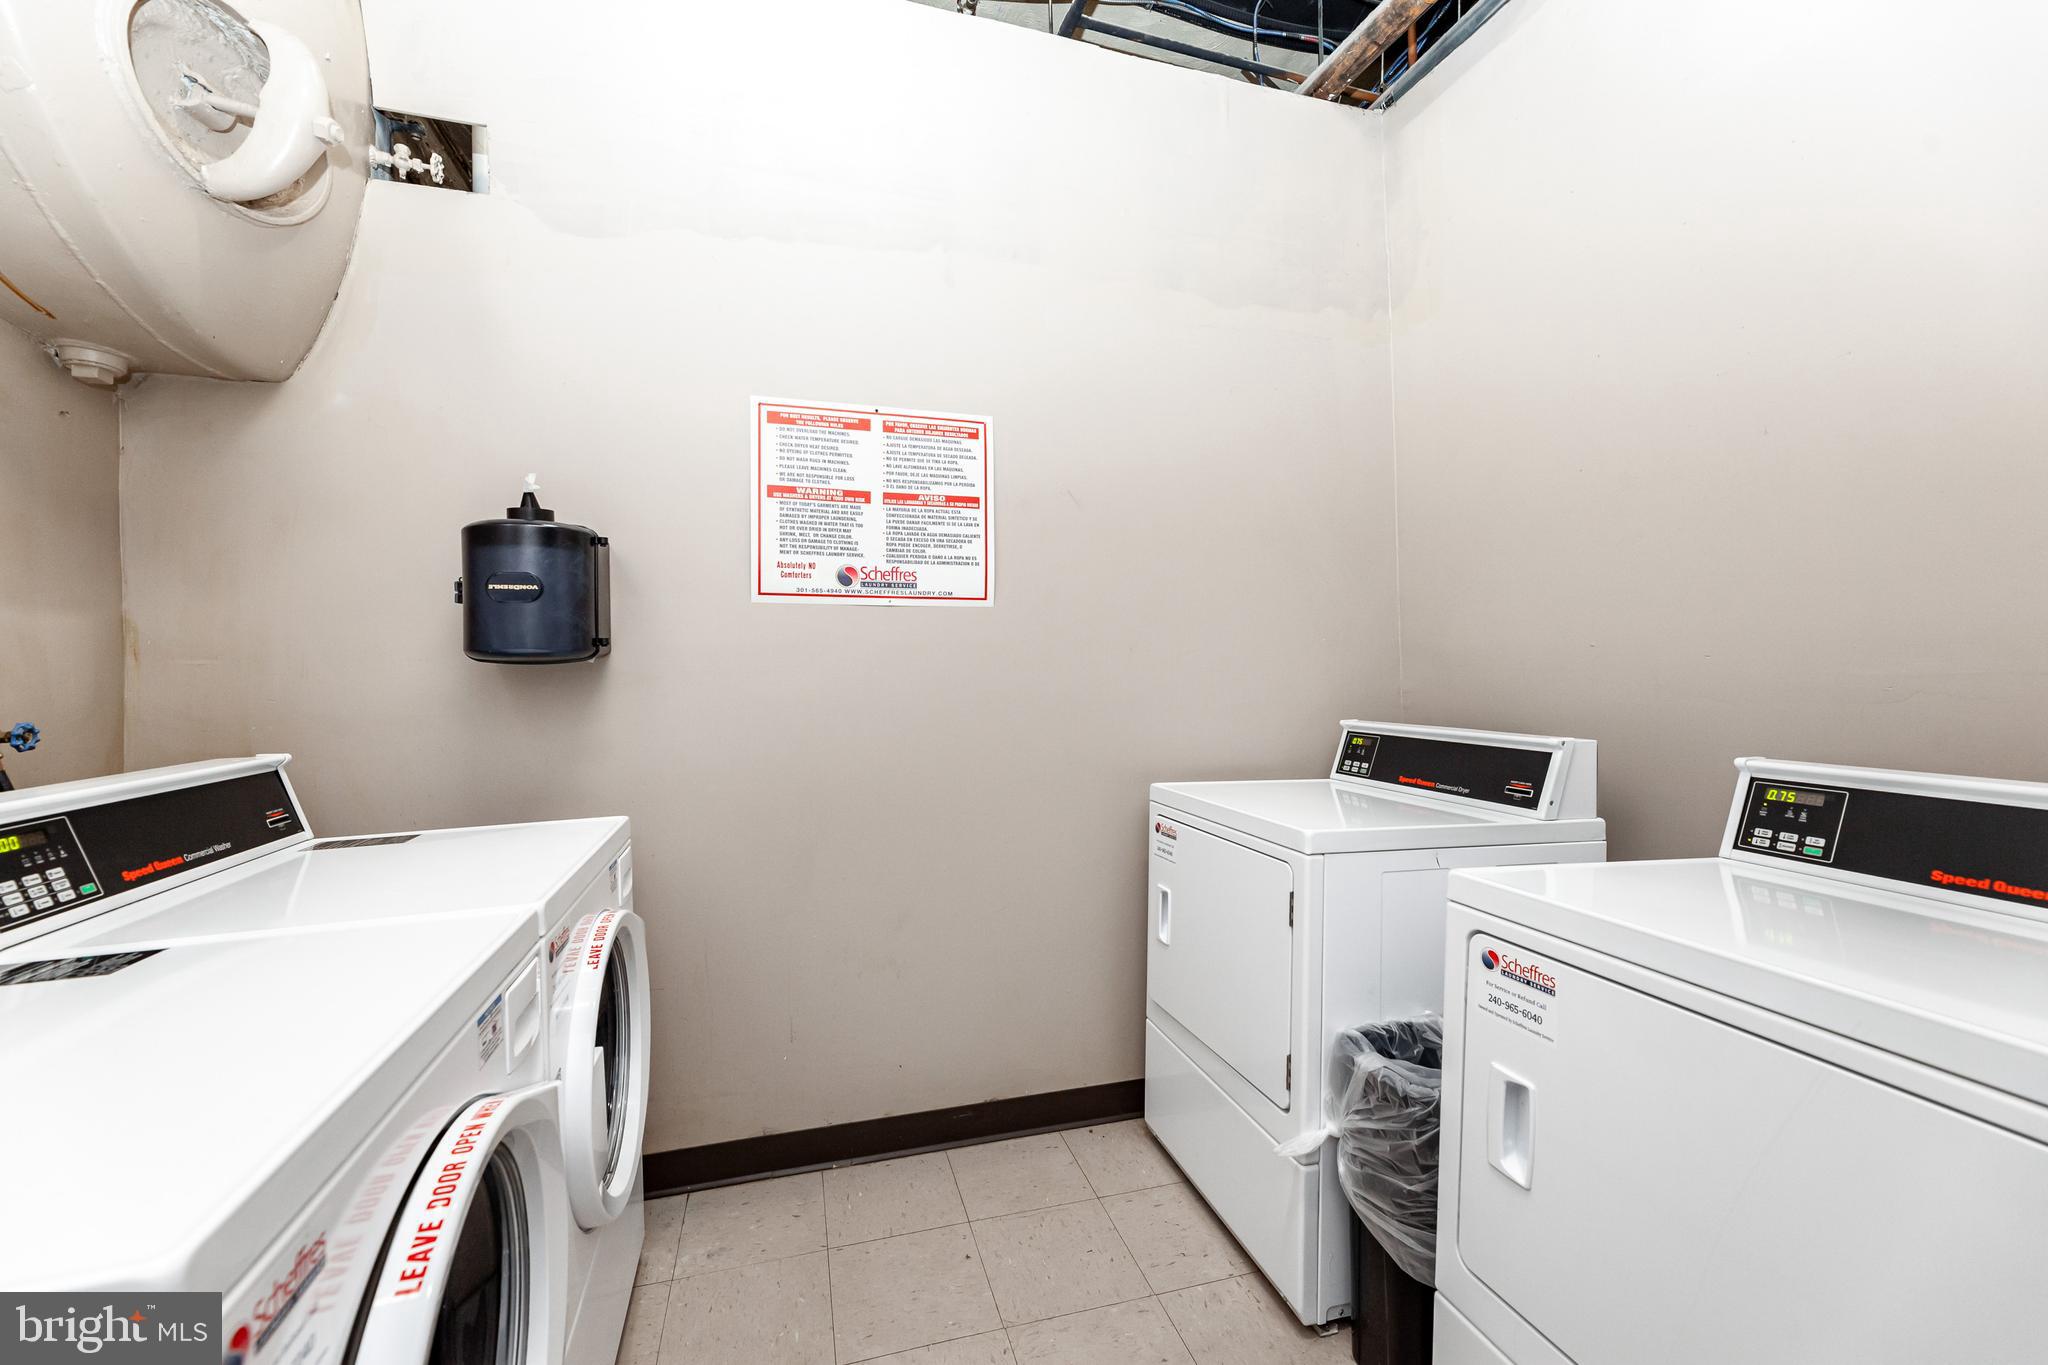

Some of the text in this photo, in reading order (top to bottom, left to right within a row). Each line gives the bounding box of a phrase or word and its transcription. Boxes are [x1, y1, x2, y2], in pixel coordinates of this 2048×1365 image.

[795, 487, 844, 497] WARNING
[918, 494, 946, 502] AVISO
[776, 560, 816, 570] Absolutely NO
[780, 571, 812, 579] Comforters
[860, 566, 917, 582] Scheffres
[844, 588, 953, 596] WWW.SCHEFFRESLAUNDRY.COM
[1435, 782, 1459, 792] Commercial
[1458, 786, 1470, 794] Dryer
[122, 842, 232, 881] Speed Queen Commercial Washer
[1930, 870, 1991, 890] Speed
[1501, 954, 1556, 989] Scheffres
[1501, 969, 1528, 984] LAUNDRY
[1488, 993, 1543, 1025] 240-965-6040
[1536, 1002, 1547, 1011] Call
[394, 1218, 444, 1297] LEAVE
[427, 1160, 468, 1210] DOOR
[451, 1123, 487, 1155] OPEN
